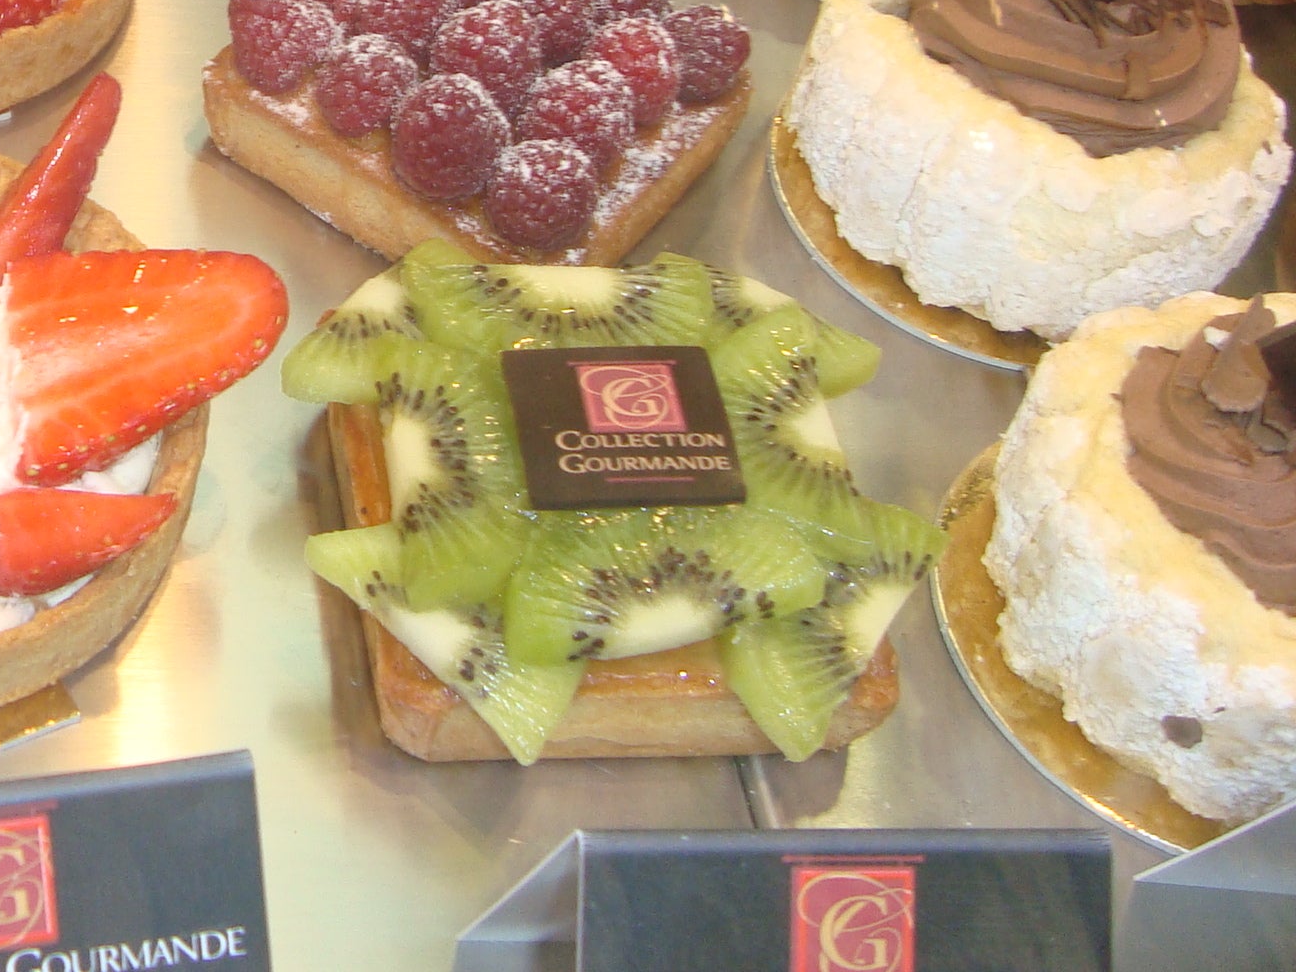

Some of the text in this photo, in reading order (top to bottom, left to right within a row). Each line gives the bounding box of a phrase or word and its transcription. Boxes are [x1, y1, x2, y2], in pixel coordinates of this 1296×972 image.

[554, 430, 726, 452] COLLECTION
[558, 453, 733, 474] GOURMANDE
[4, 925, 248, 972] GOURMANDE
